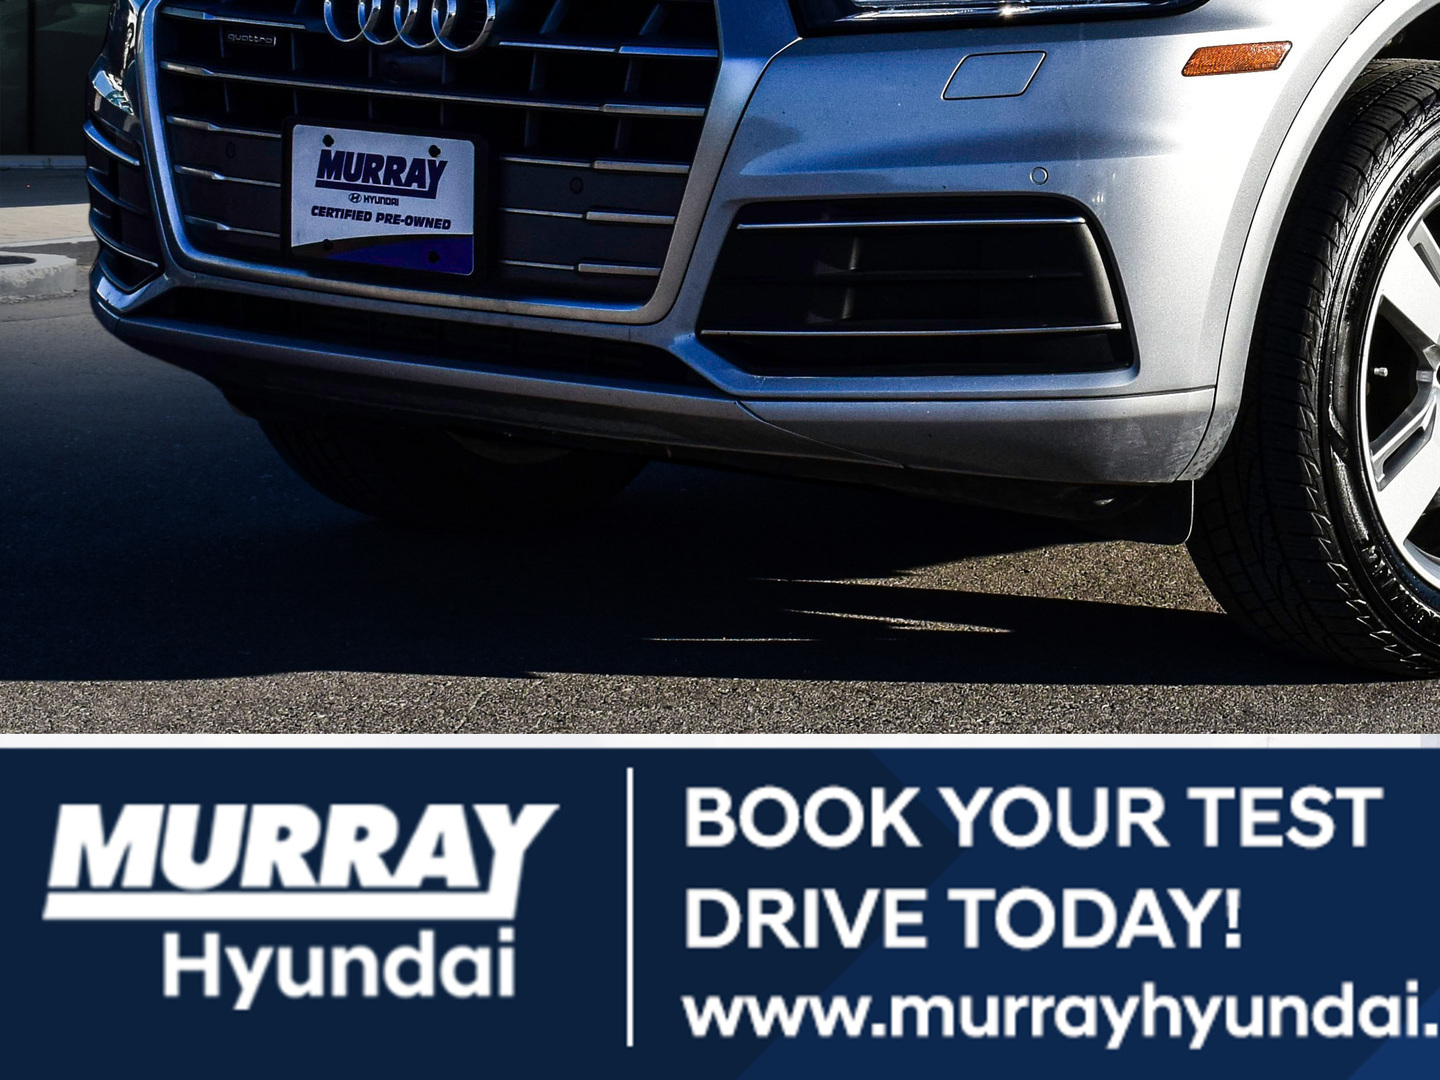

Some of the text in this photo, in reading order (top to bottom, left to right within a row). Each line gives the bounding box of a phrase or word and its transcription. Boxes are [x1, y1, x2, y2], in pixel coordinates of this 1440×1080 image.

[227, 33, 273, 44] quattro
[315, 149, 448, 199] MURRAY
[363, 194, 399, 206] HYUNDAI
[311, 205, 452, 230] CERTIFIED PRE-OWNED
